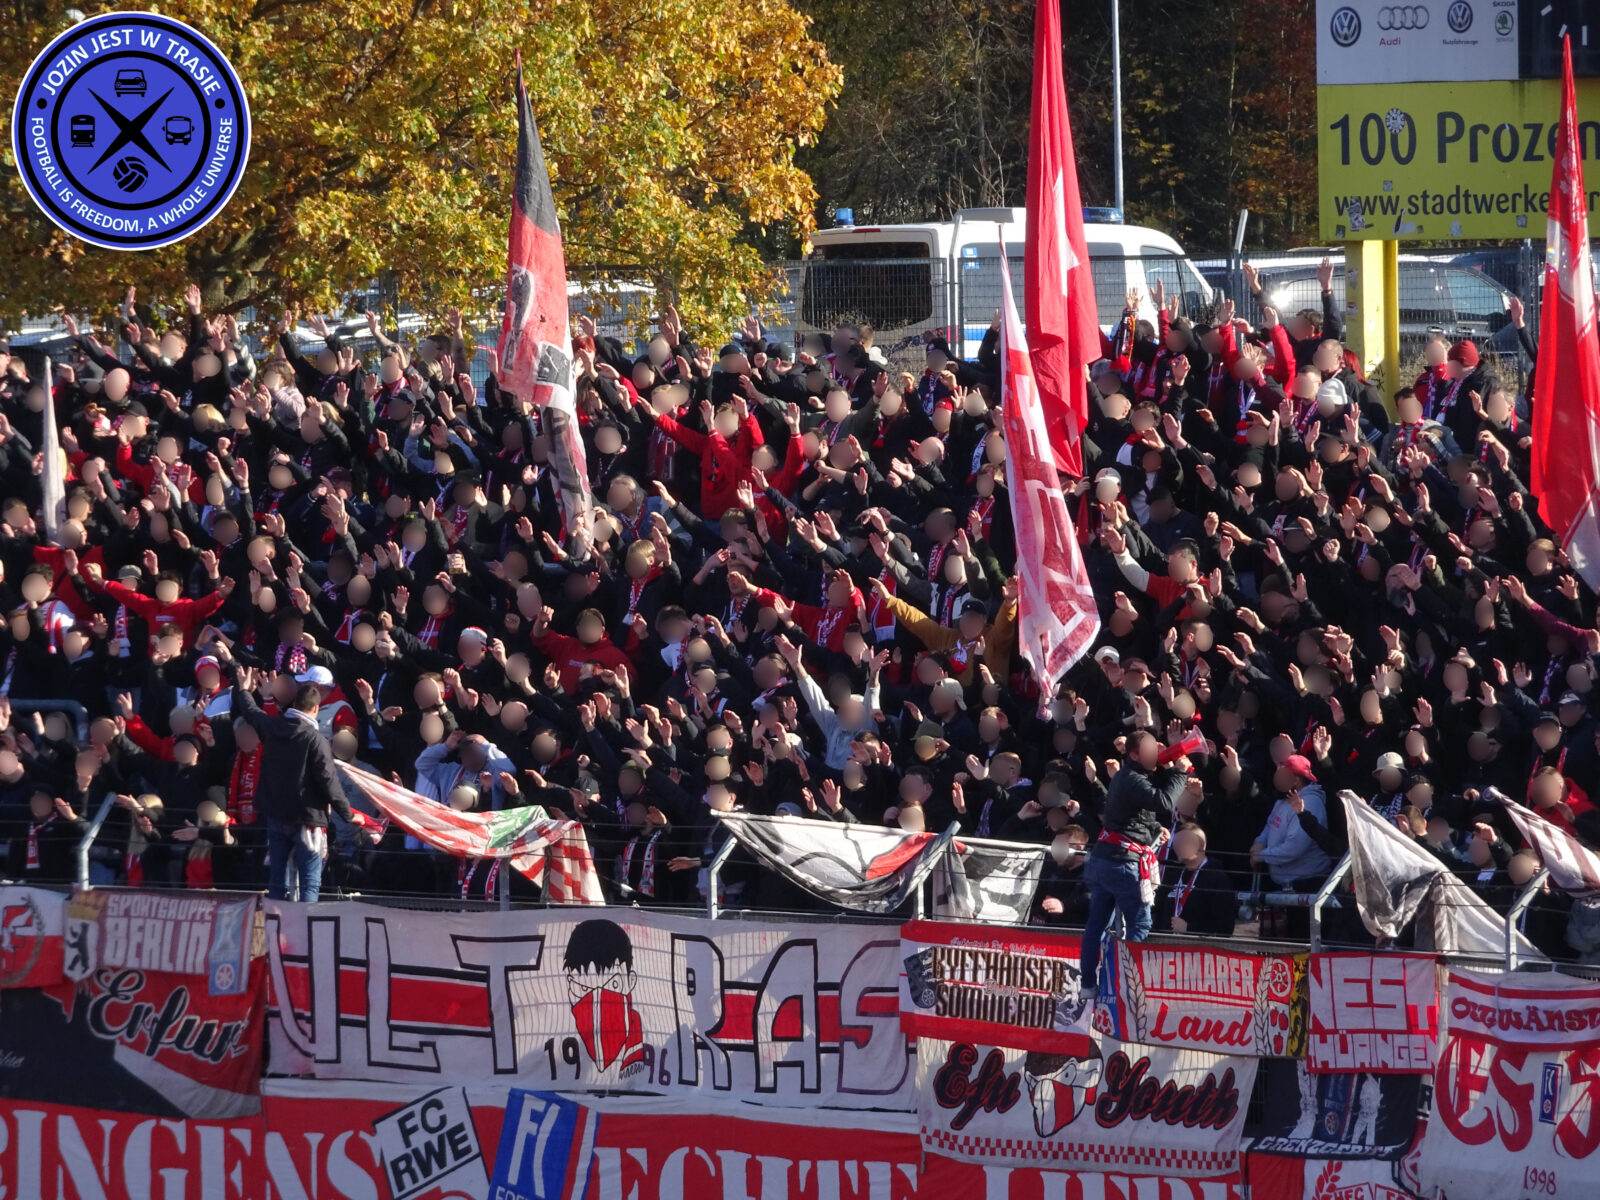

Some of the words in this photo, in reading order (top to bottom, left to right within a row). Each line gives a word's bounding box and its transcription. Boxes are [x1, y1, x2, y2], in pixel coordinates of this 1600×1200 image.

[1379, 37, 1401, 46] Audi
[1330, 109, 1417, 166] 100
[107, 894, 215, 921] SPORTGRUPPE
[105, 917, 211, 974] BERLIN
[1142, 950, 1254, 998] WEIMARER
[1309, 956, 1437, 1031] NEST
[1149, 1002, 1253, 1047] Land
[1095, 1051, 1239, 1130] Youth
[397, 1098, 447, 1149] FC
[389, 1121, 473, 1193] RWE
[1523, 1165, 1557, 1196] 1998
